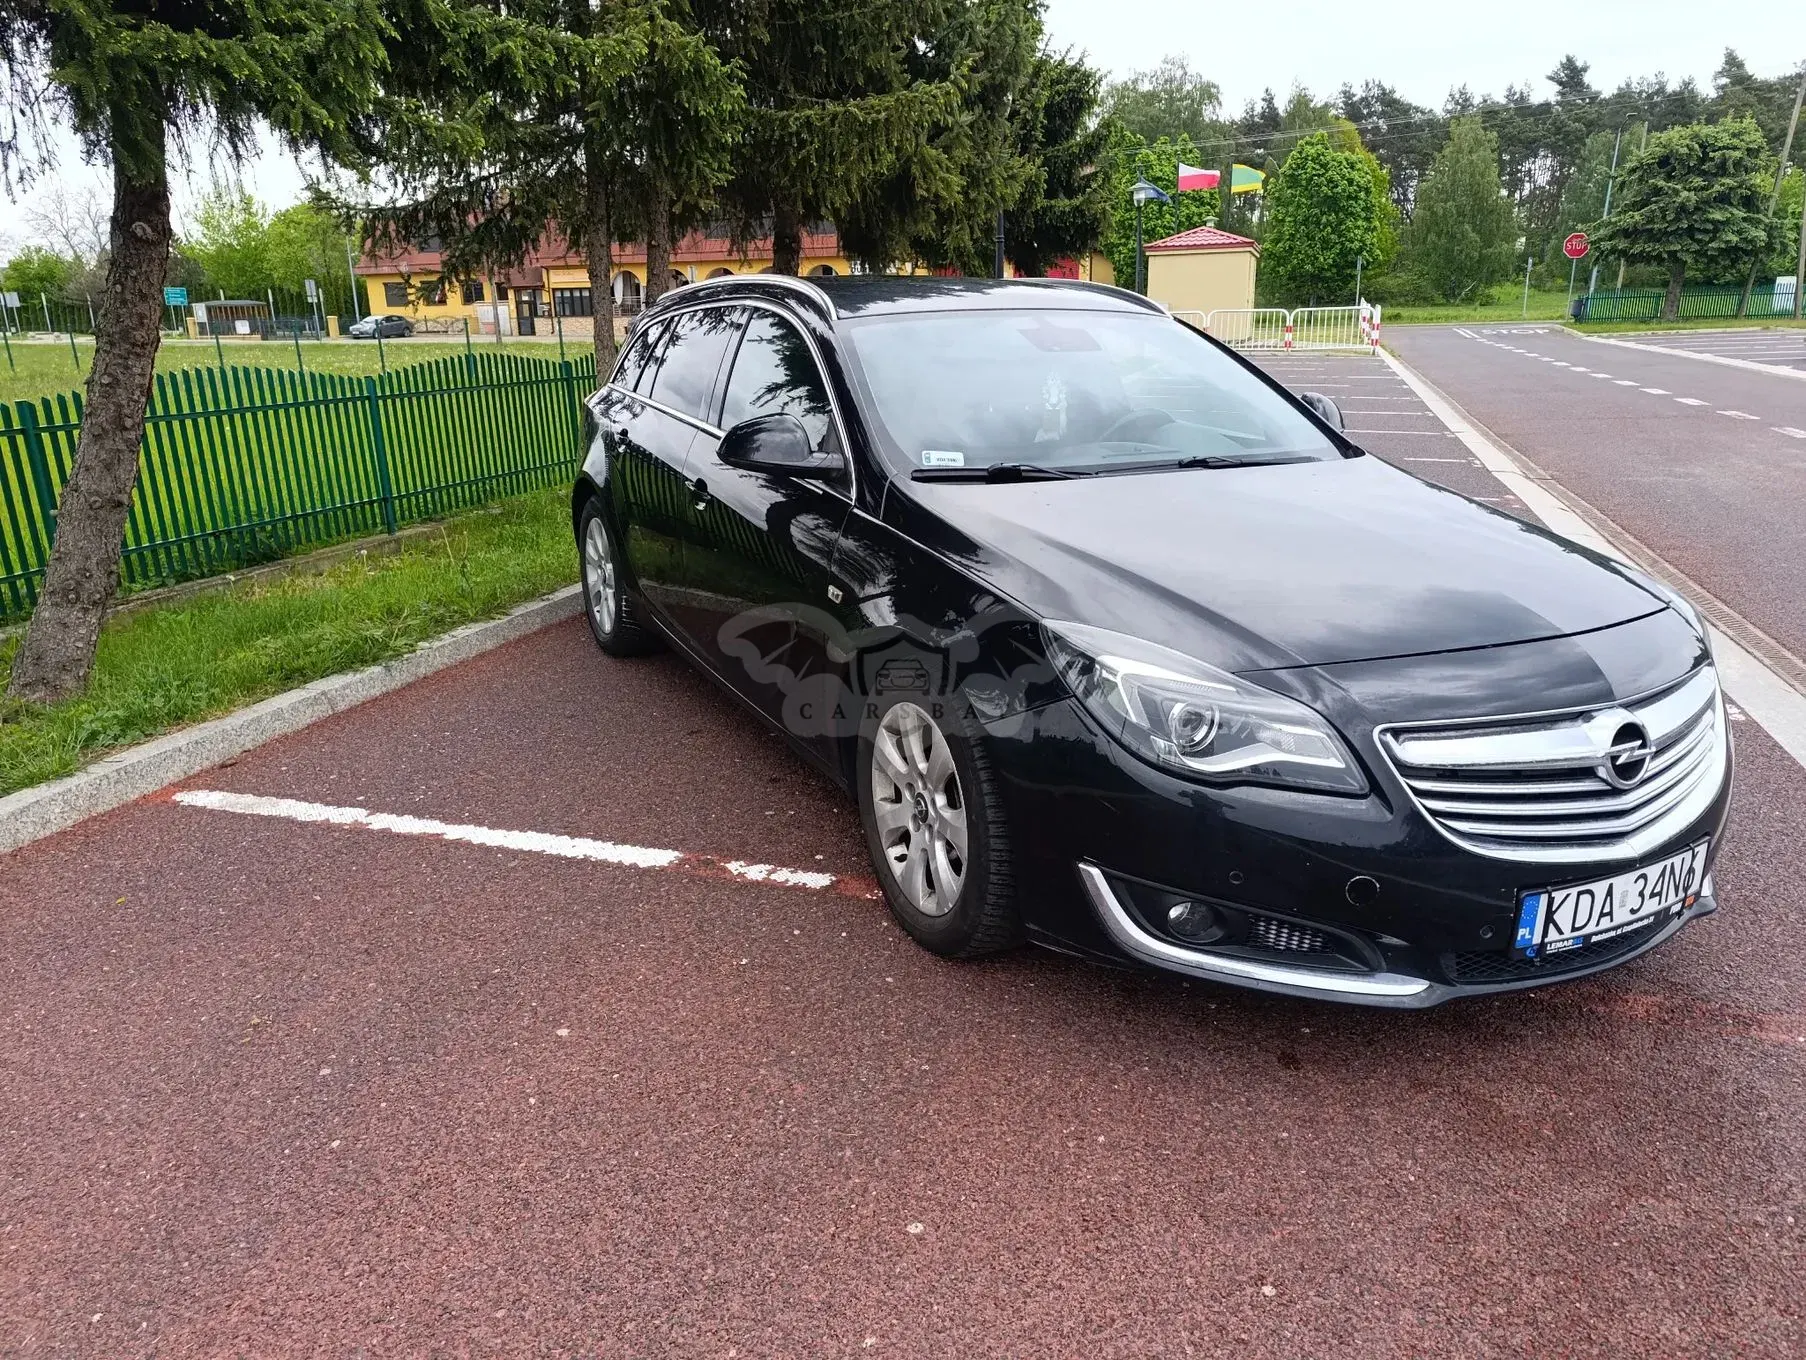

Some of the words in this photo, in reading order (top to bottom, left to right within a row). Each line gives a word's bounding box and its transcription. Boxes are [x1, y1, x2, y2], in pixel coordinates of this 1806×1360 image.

[1566, 241, 1587, 250] STOP
[1543, 882, 1614, 939] KDA
[1629, 850, 1700, 916] 34N6
[1517, 927, 1532, 940] PL
